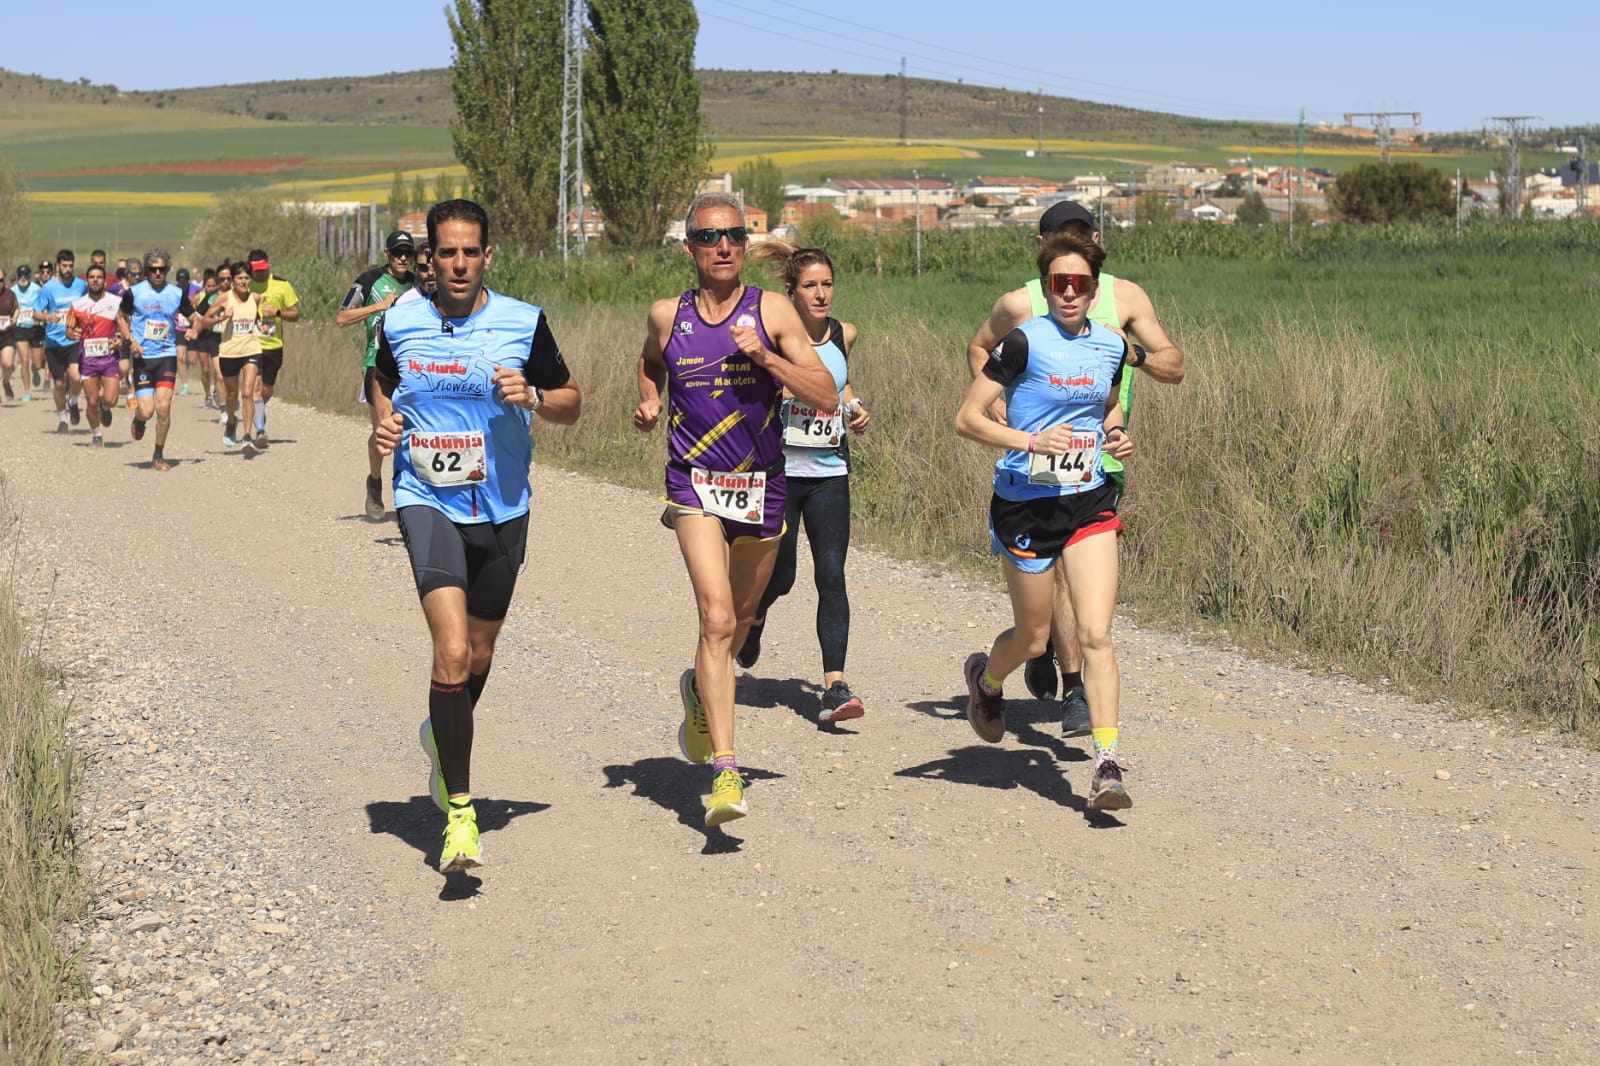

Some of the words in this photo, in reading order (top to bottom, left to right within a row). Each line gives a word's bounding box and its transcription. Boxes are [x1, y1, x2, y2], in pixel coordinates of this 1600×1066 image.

[721, 362, 751, 372] PRIM
[436, 378, 482, 394] FLOWERS
[714, 375, 756, 387] Macotera
[802, 418, 832, 436] 136
[410, 433, 483, 449] bedunia
[432, 452, 462, 472] 62
[1046, 452, 1085, 472] 144
[709, 488, 749, 510] 178
